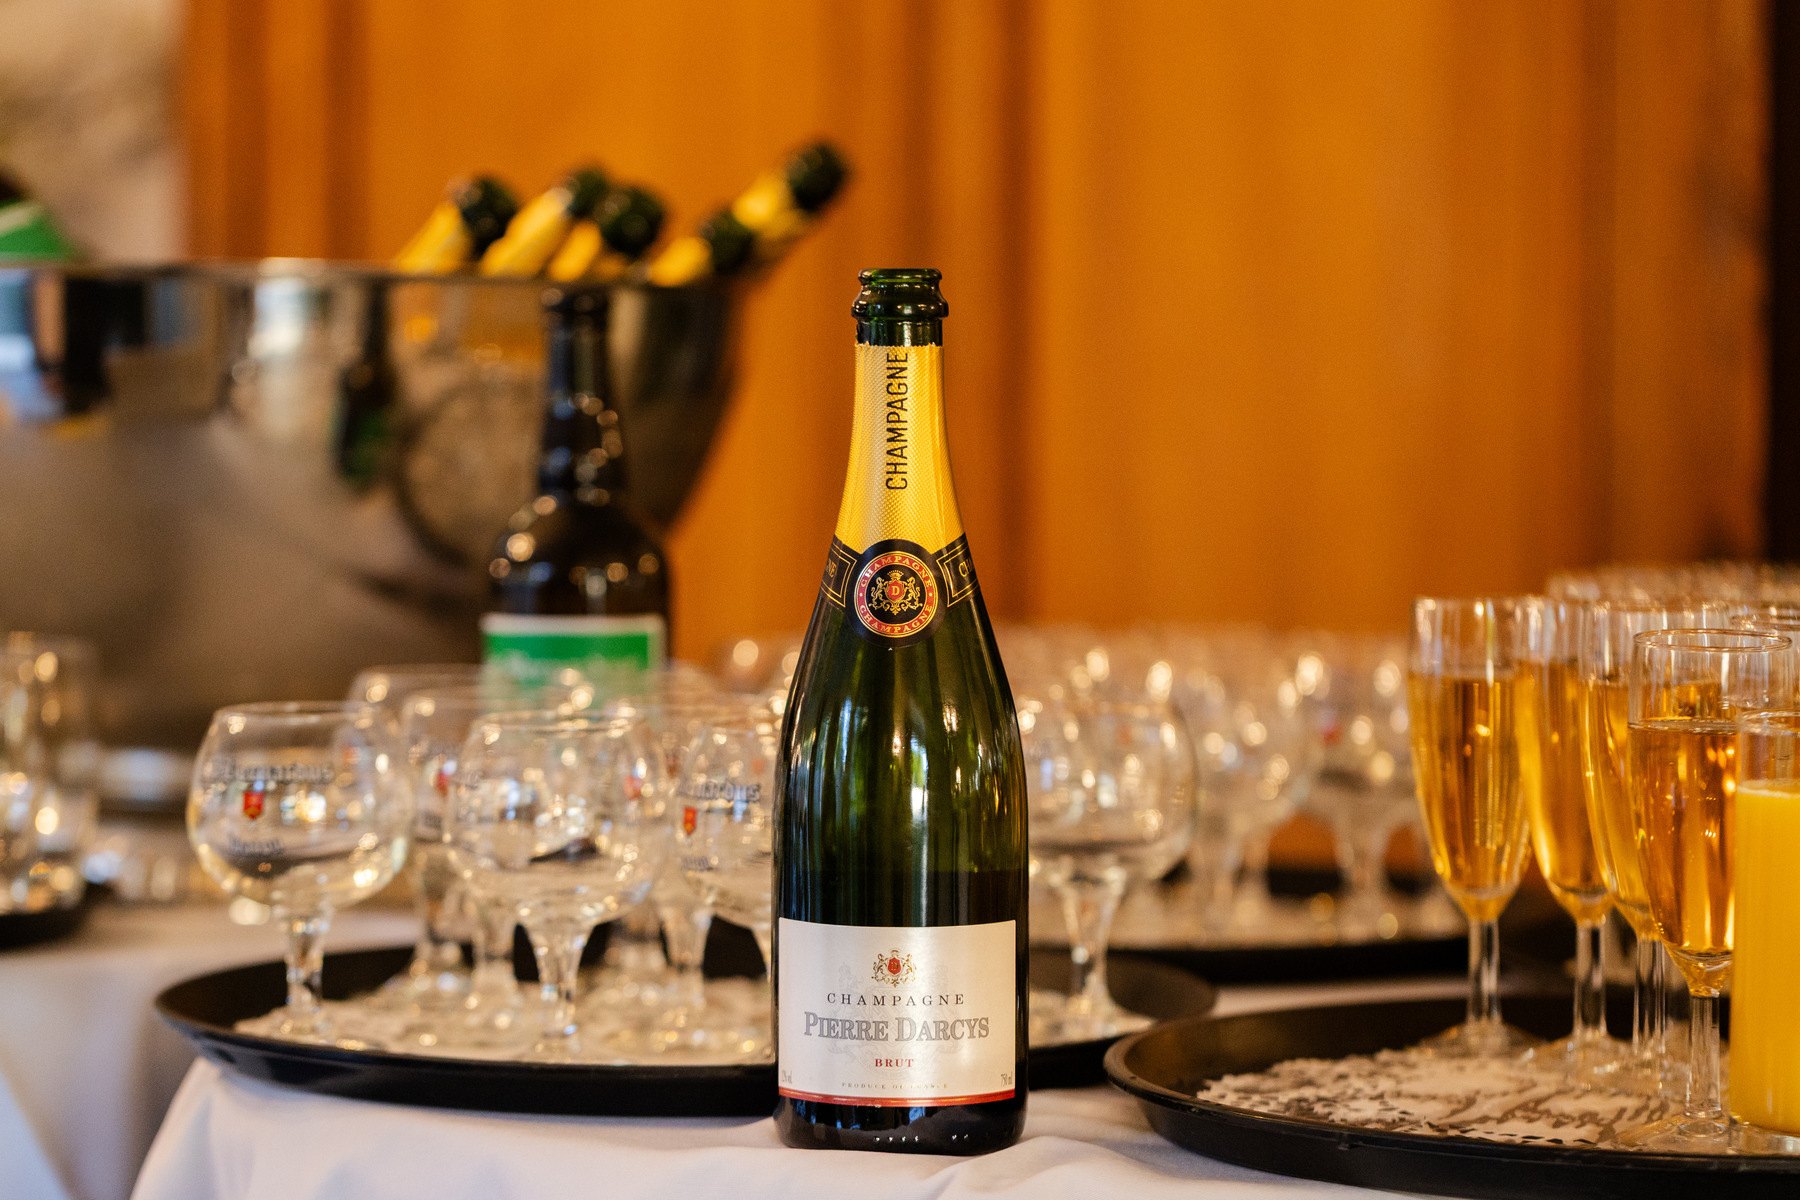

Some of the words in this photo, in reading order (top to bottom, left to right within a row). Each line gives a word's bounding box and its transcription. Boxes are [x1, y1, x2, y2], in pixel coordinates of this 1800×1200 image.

[886, 353, 908, 490] CHAMPAGNE
[860, 555, 933, 588] CHAMPAGNE
[892, 585, 900, 597] D
[859, 604, 933, 634] CHAMPAGNE
[890, 961, 899, 971] D
[827, 992, 965, 1006] CHAMPAGNE
[804, 1011, 889, 1042] PIERRE
[895, 1016, 990, 1042] DARCYS
[874, 1058, 914, 1068] BRUT
[841, 1082, 886, 1090] PRODUCE
